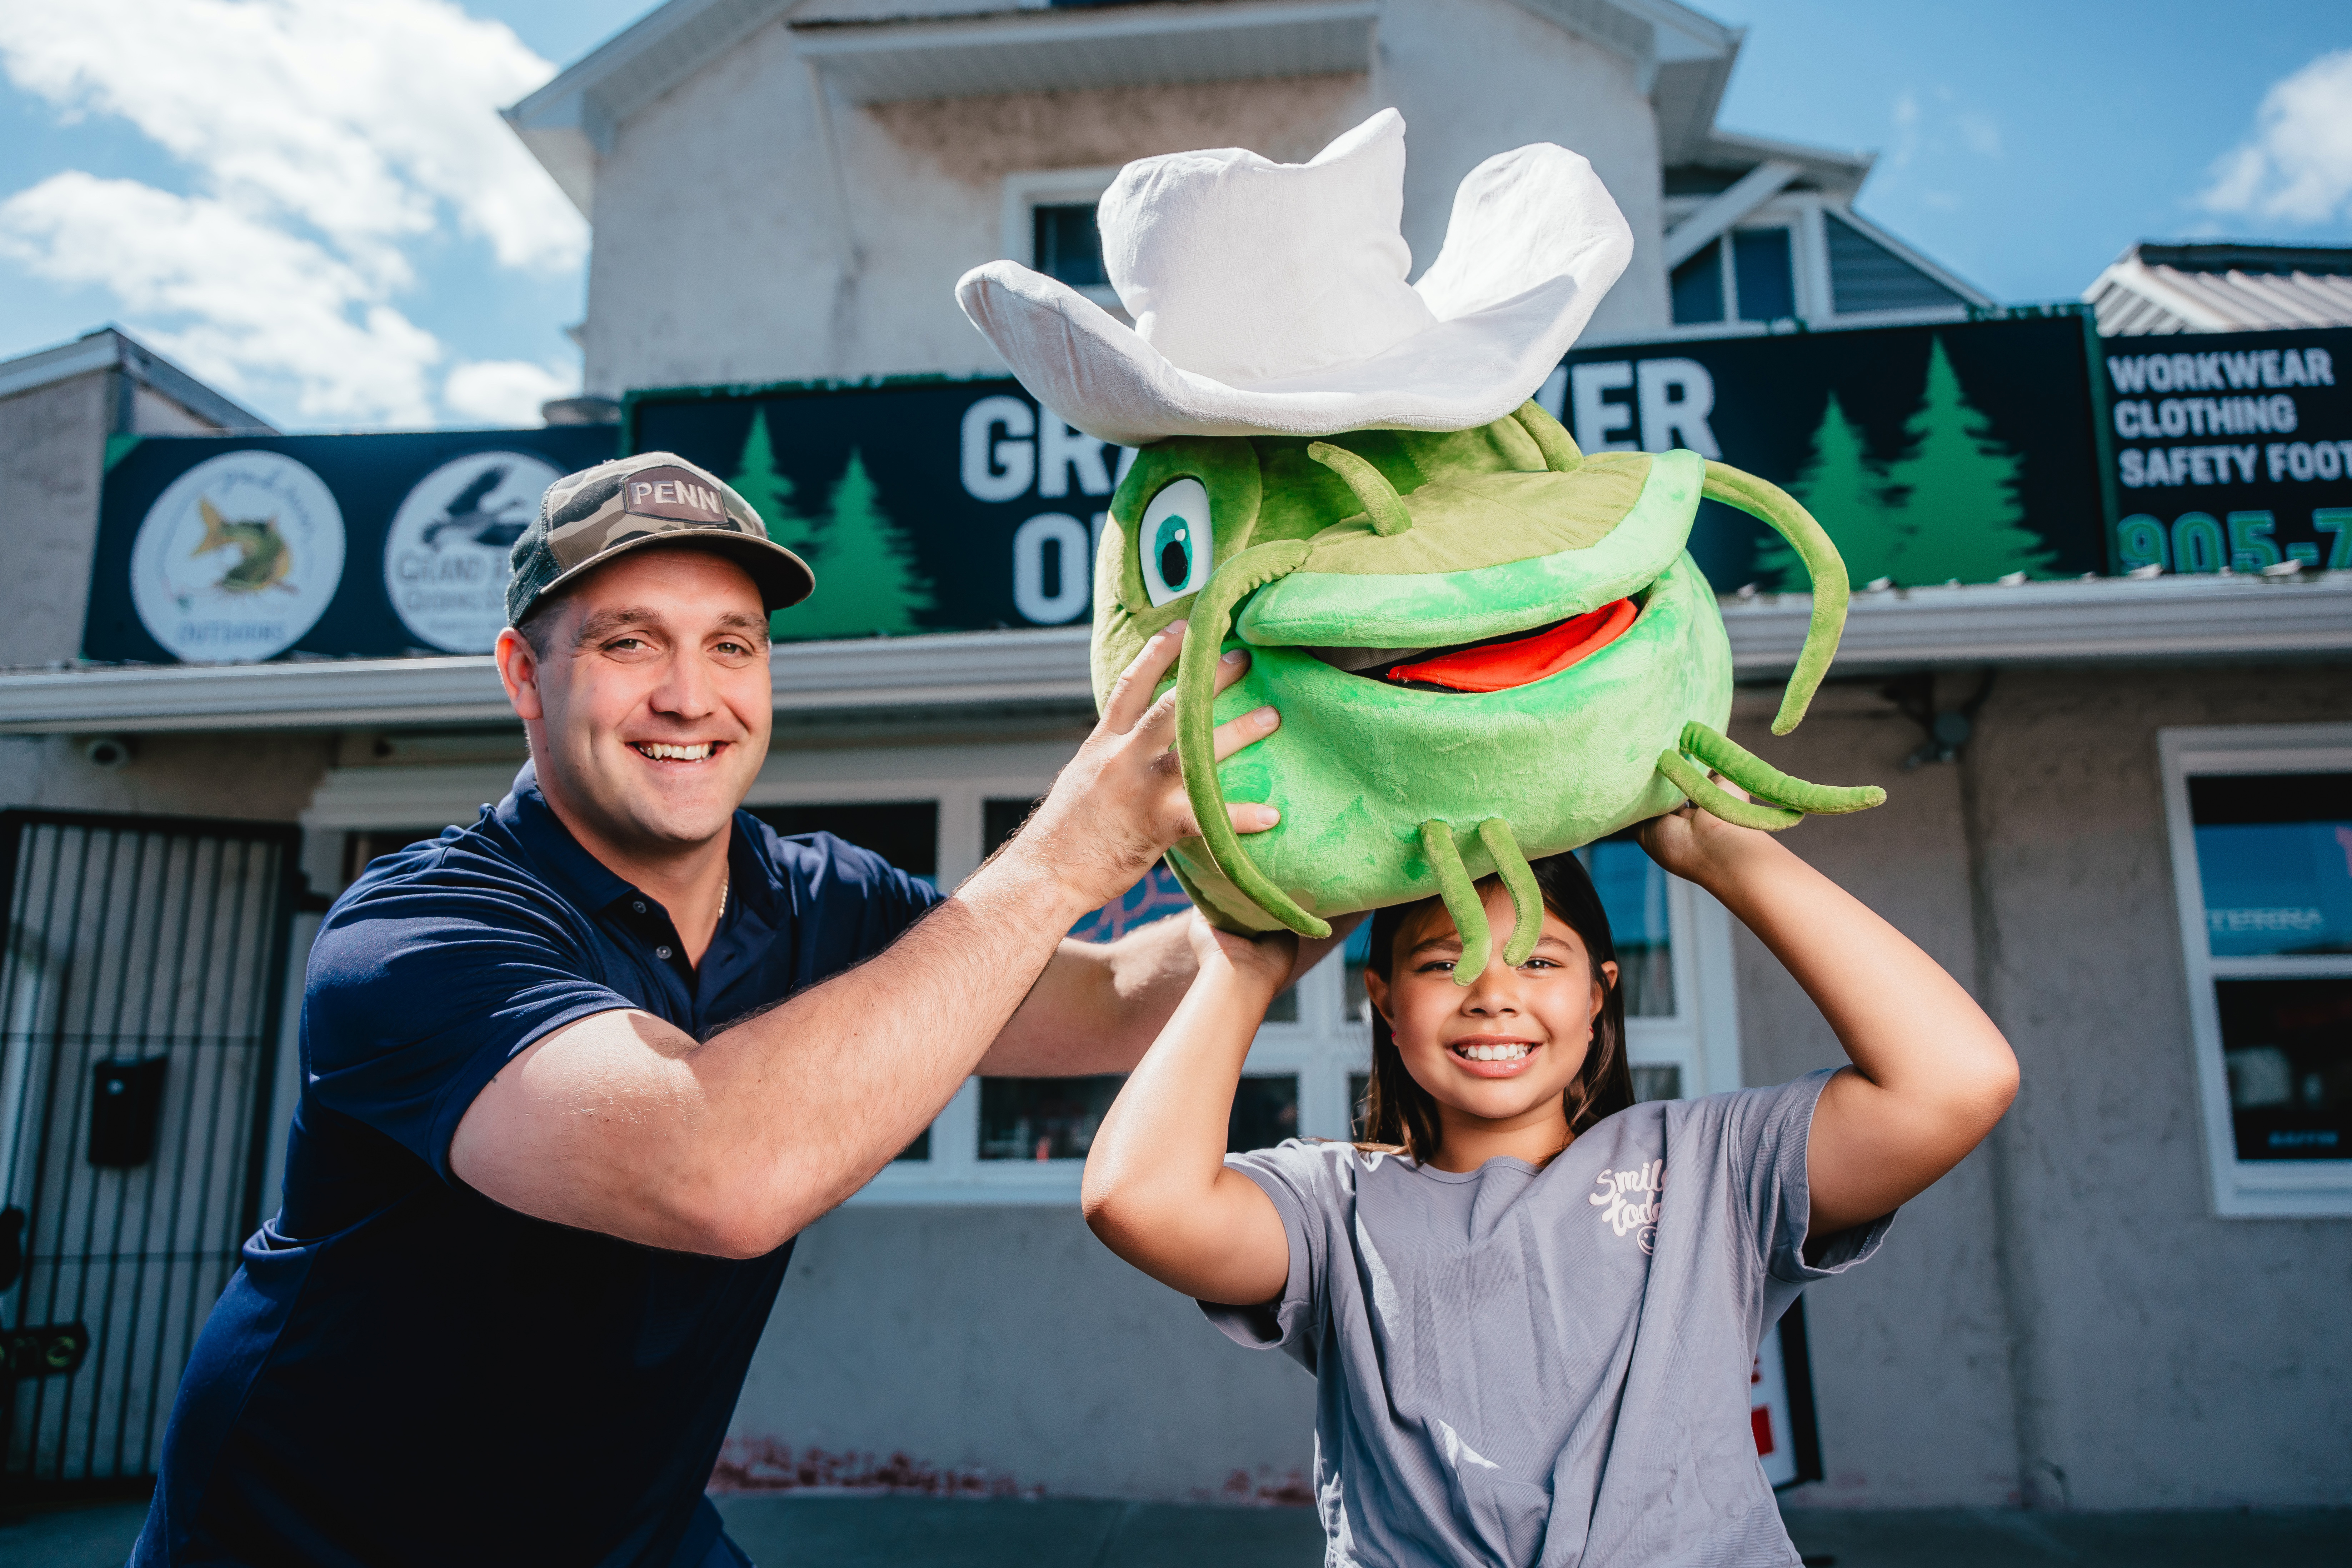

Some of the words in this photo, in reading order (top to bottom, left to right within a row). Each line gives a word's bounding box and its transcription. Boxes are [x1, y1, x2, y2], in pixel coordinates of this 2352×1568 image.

[2107, 348, 2334, 393] WORKWEAR
[2114, 394, 2297, 439] CLOTHING
[960, 394, 1139, 503] GR
[2119, 444, 2258, 488] SAFETY
[629, 480, 721, 514] PENN
[1013, 512, 1108, 624] O
